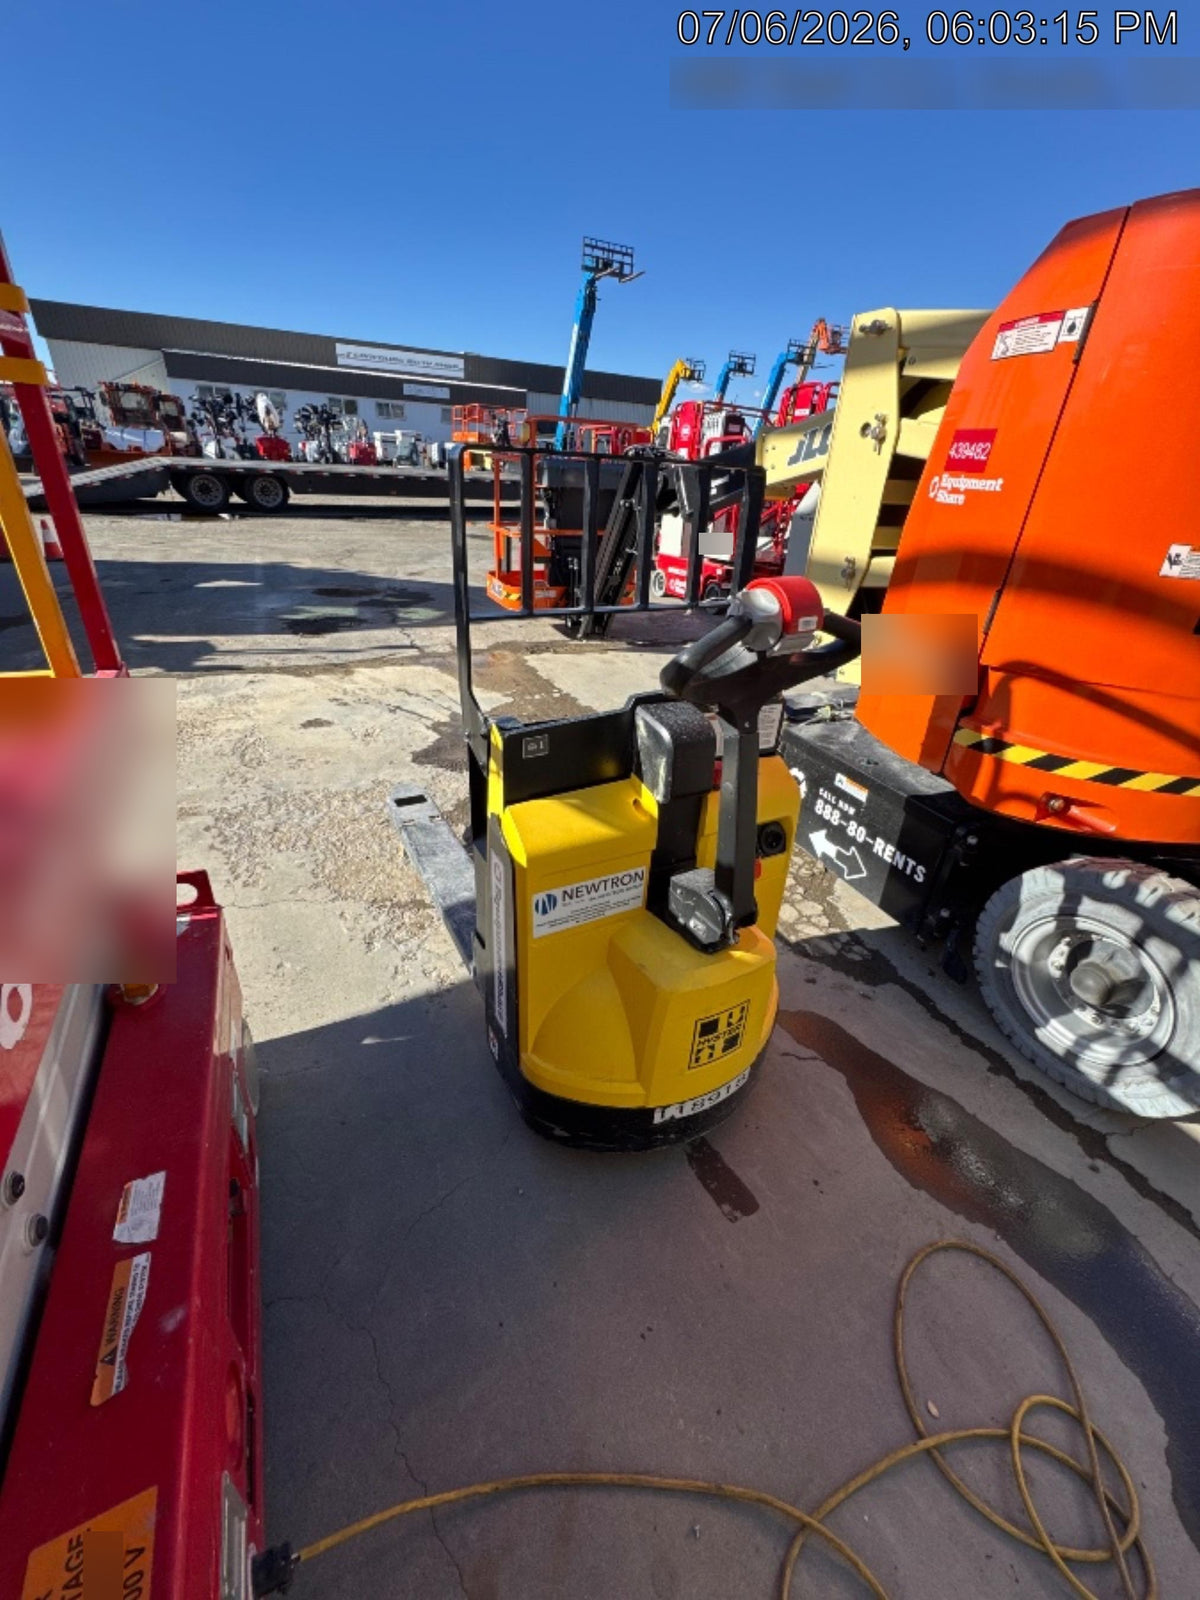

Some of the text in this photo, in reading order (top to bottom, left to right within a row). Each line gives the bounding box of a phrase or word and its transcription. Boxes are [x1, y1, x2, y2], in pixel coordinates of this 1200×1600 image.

[935, 489, 965, 505] Share
[941, 473, 1003, 492] Equipment
[814, 799, 926, 882] 888-80-RENTS
[561, 869, 644, 902] NEWTRON
[105, 1286, 126, 1346] WARNING
